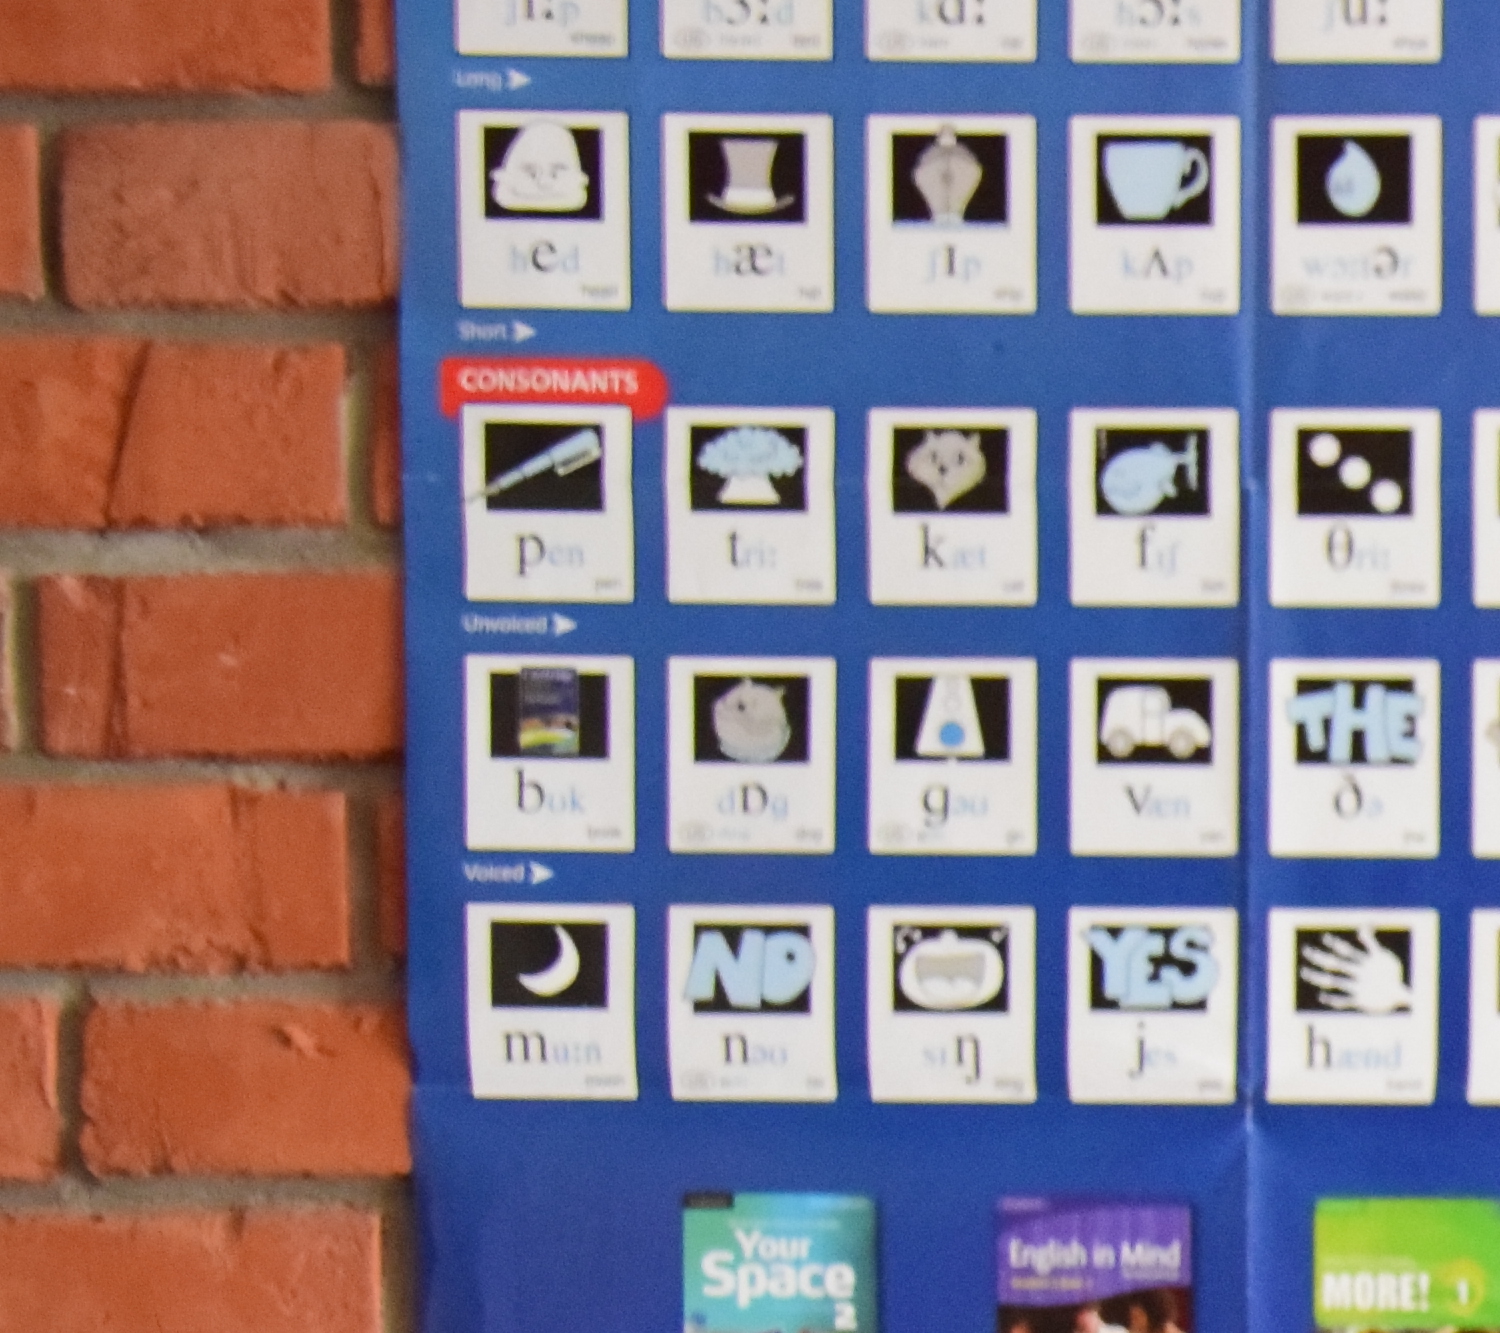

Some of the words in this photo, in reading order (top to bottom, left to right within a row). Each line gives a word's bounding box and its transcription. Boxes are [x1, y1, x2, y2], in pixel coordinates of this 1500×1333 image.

[457, 321, 508, 342] Short
[459, 368, 639, 395] CONSONANTS
[463, 614, 548, 635] Unvoiced
[1287, 681, 1423, 763] THE
[463, 862, 525, 884] Voiced
[684, 929, 817, 1009] NO
[1081, 925, 1219, 1008] YES
[733, 1228, 811, 1260] Your
[1010, 1237, 1088, 1275] English
[1092, 1241, 1116, 1270] in
[1120, 1238, 1182, 1270] Mind
[701, 1249, 856, 1309] Space
[1322, 1271, 1430, 1313] MORE!
[834, 1302, 858, 1331] 2
